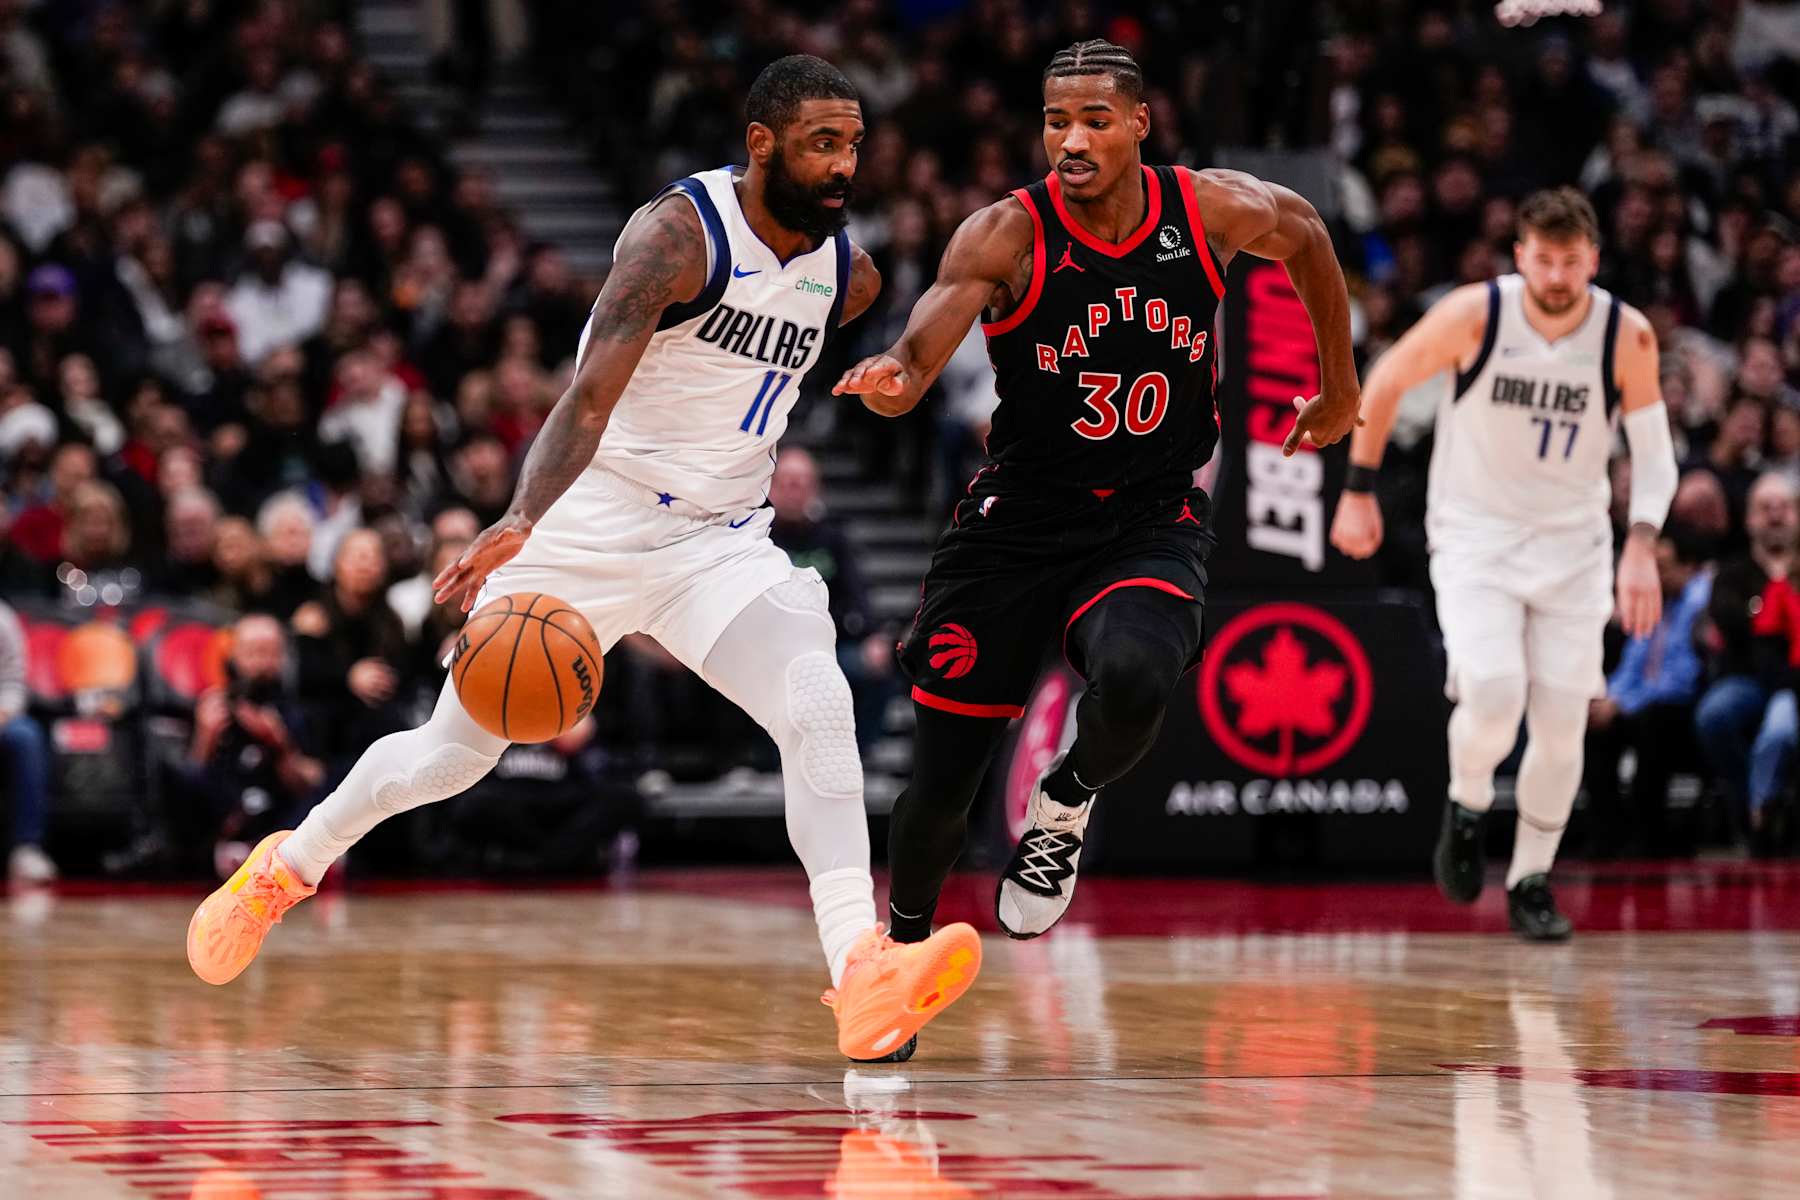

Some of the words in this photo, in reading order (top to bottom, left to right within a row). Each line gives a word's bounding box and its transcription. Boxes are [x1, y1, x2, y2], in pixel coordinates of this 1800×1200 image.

[1156, 252, 1174, 263] Sun
[1174, 246, 1191, 259] Life
[795, 276, 833, 297] chime
[695, 303, 820, 370] DALLAS
[1036, 286, 1207, 374] RAPTORS
[739, 370, 793, 437] 11
[1071, 371, 1170, 440] 30
[1491, 375, 1590, 413] DALLAS
[1531, 416, 1579, 460] 77
[1165, 780, 1238, 816] AIR
[1240, 778, 1409, 815] CANADA
